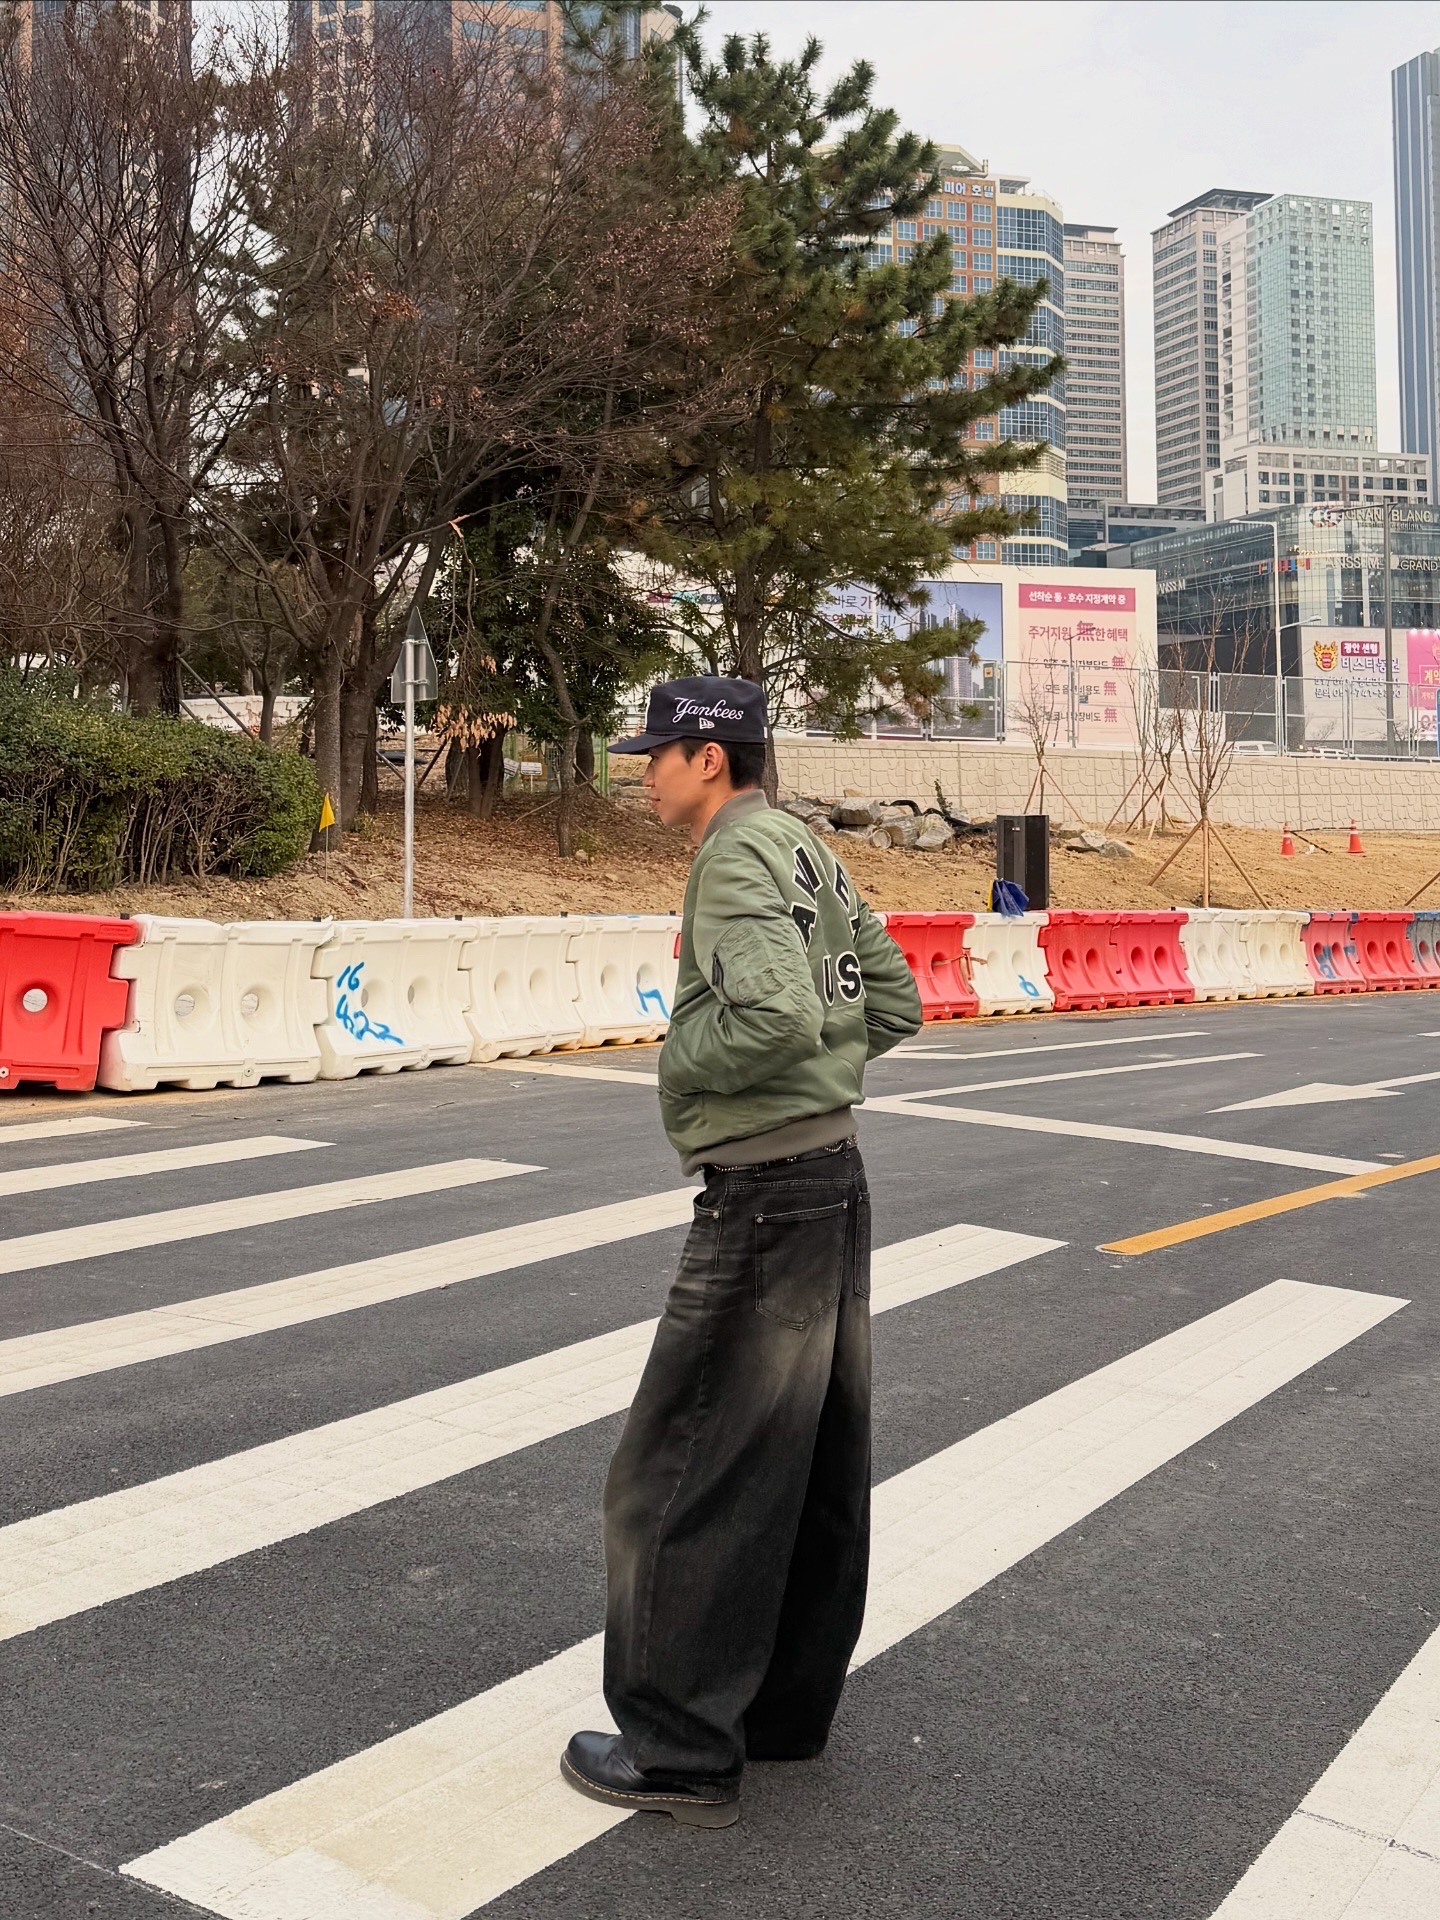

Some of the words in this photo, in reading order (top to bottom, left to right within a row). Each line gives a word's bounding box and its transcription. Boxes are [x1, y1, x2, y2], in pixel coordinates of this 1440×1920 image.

[971, 184, 994, 198] 호텔
[1345, 507, 1386, 522] GRAN
[1392, 509, 1431, 523] BLANC
[1400, 560, 1438, 571] GRAND
[1029, 591, 1053, 602] 선착순
[1085, 593, 1116, 605] 지정계약
[1118, 594, 1126, 605] 중
[1028, 626, 1072, 641] 주거지원
[1343, 642, 1360, 654] 광안
[1104, 681, 1117, 696] 無
[672, 697, 744, 724] Yankees
[1104, 707, 1118, 723] 無
